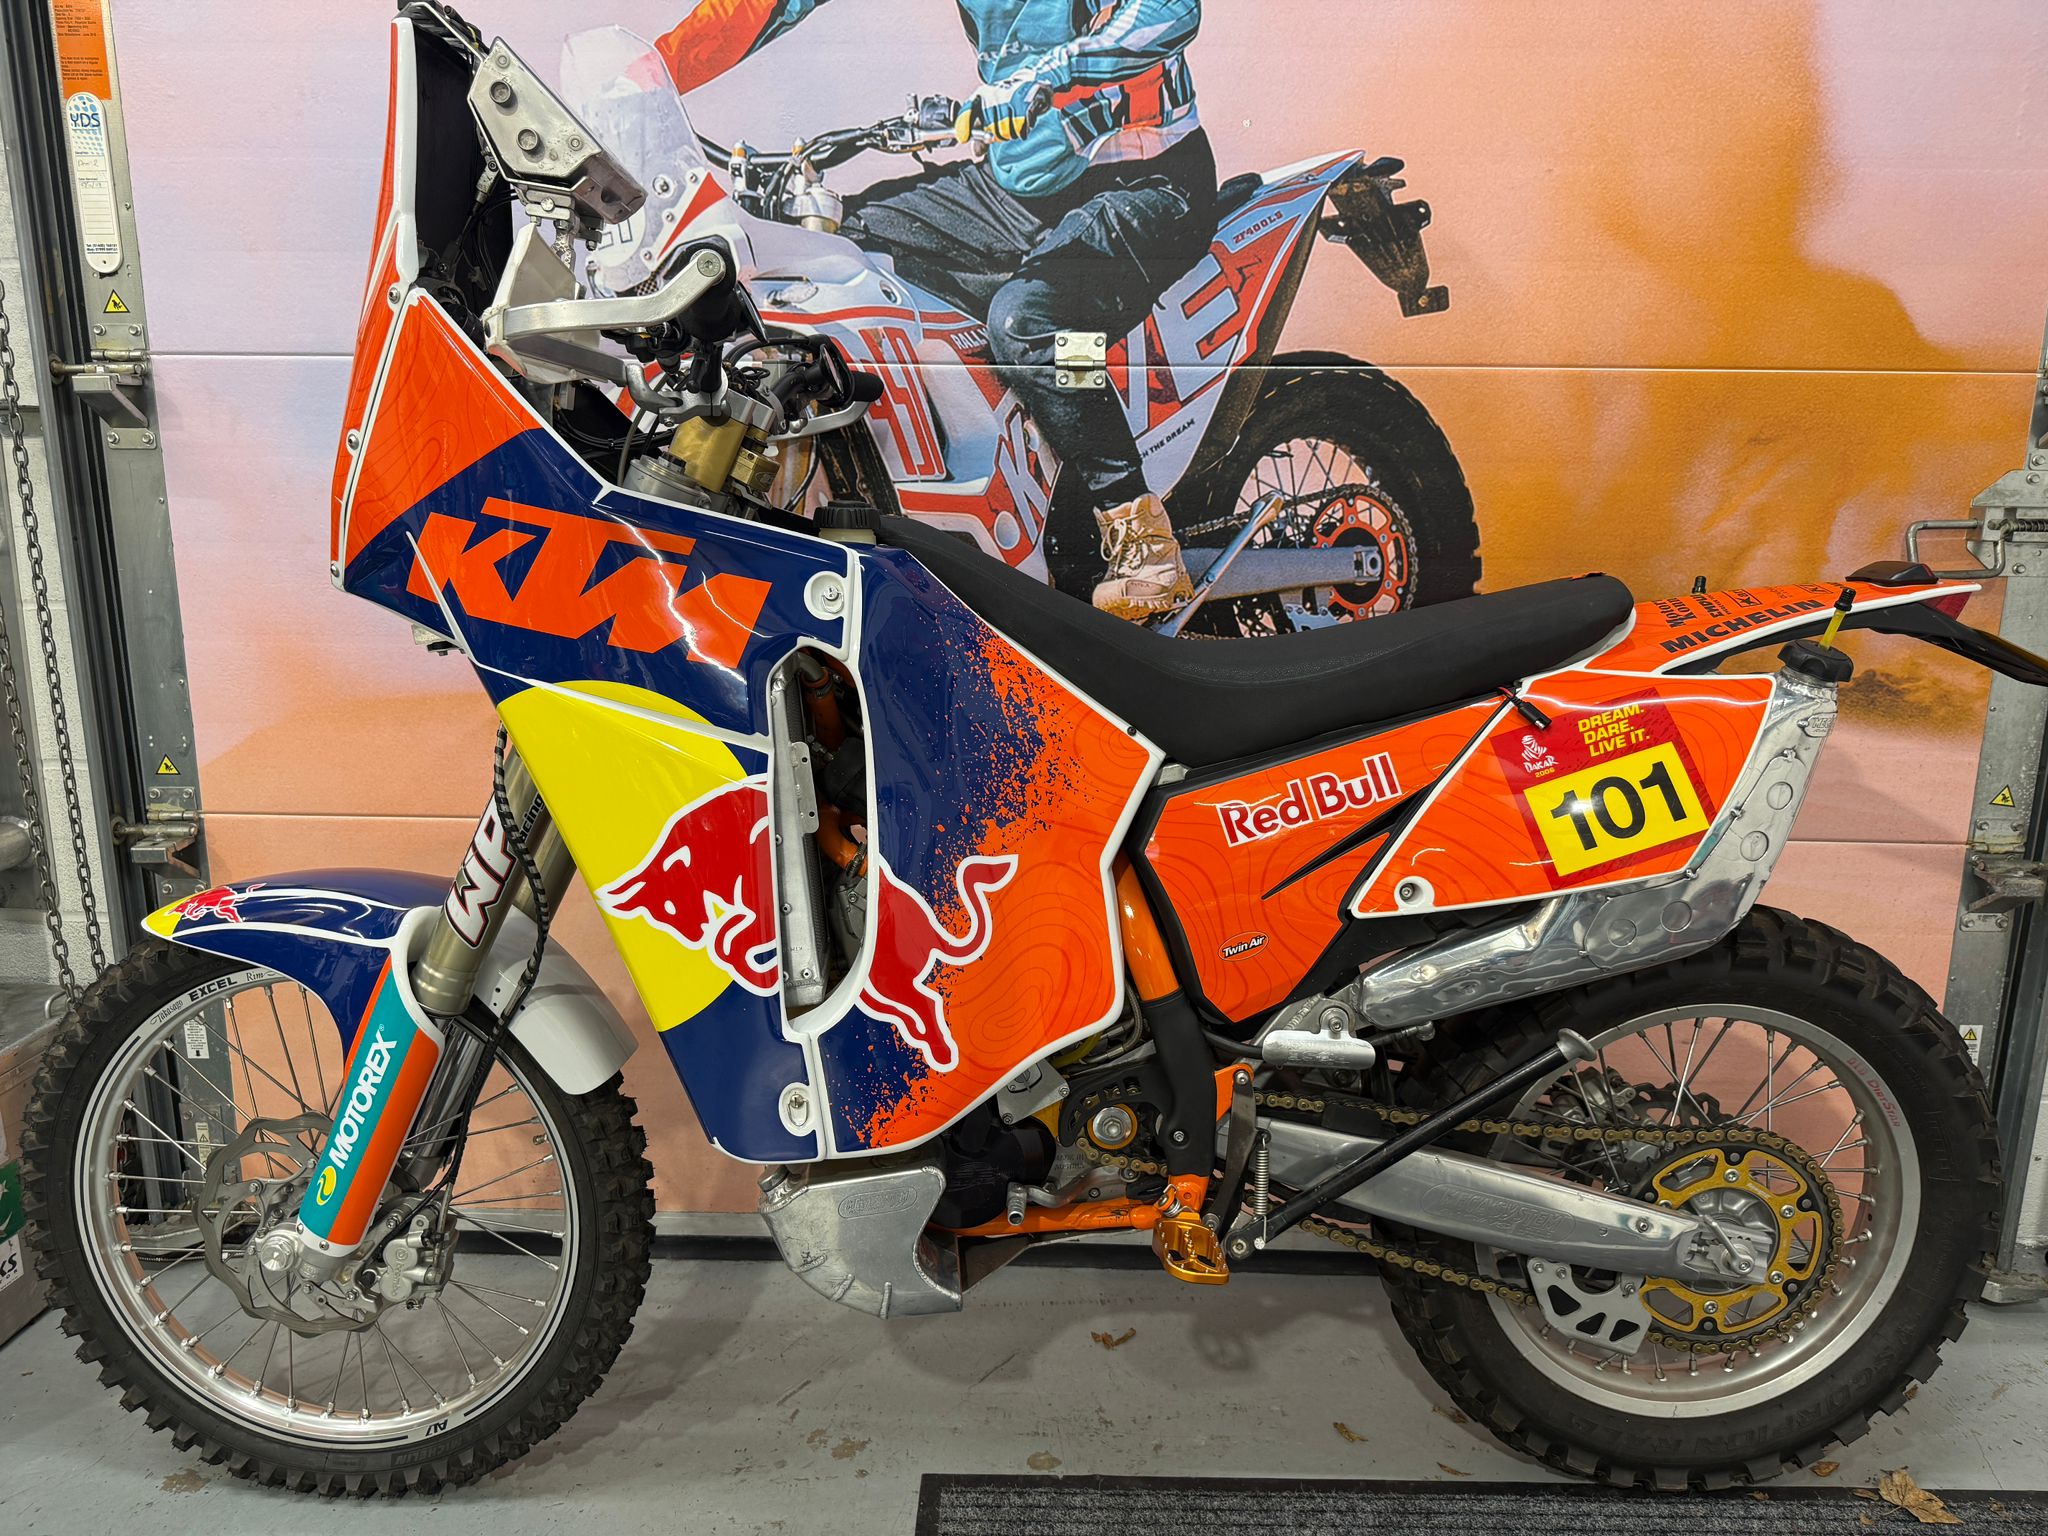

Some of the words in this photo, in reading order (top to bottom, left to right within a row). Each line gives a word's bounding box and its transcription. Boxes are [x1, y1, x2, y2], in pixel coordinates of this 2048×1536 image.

[70, 112, 101, 128] YDS
[950, 327, 990, 350] RALLY
[1149, 439, 1166, 454] THE
[1165, 418, 1196, 443] DREAM
[406, 497, 772, 668] KTM
[1660, 600, 1825, 653] MICHELIN
[1577, 703, 1644, 733] DREAM.
[1583, 719, 1634, 745] DARE.
[1589, 736, 1627, 757] LIVE
[1630, 728, 1650, 745] IT.
[1523, 755, 1558, 773] DAKAR
[1535, 767, 1556, 778] 2006
[1218, 779, 1312, 847] Red
[1307, 752, 1402, 819] Bull
[1550, 760, 1688, 851] 101
[1223, 942, 1248, 957] Twin
[1249, 936, 1265, 948] Air
[150, 999, 184, 1025] Takasago
[188, 977, 238, 1002] EXCEL
[246, 970, 265, 981] Rim
[328, 1030, 398, 1169] MOTOREX
